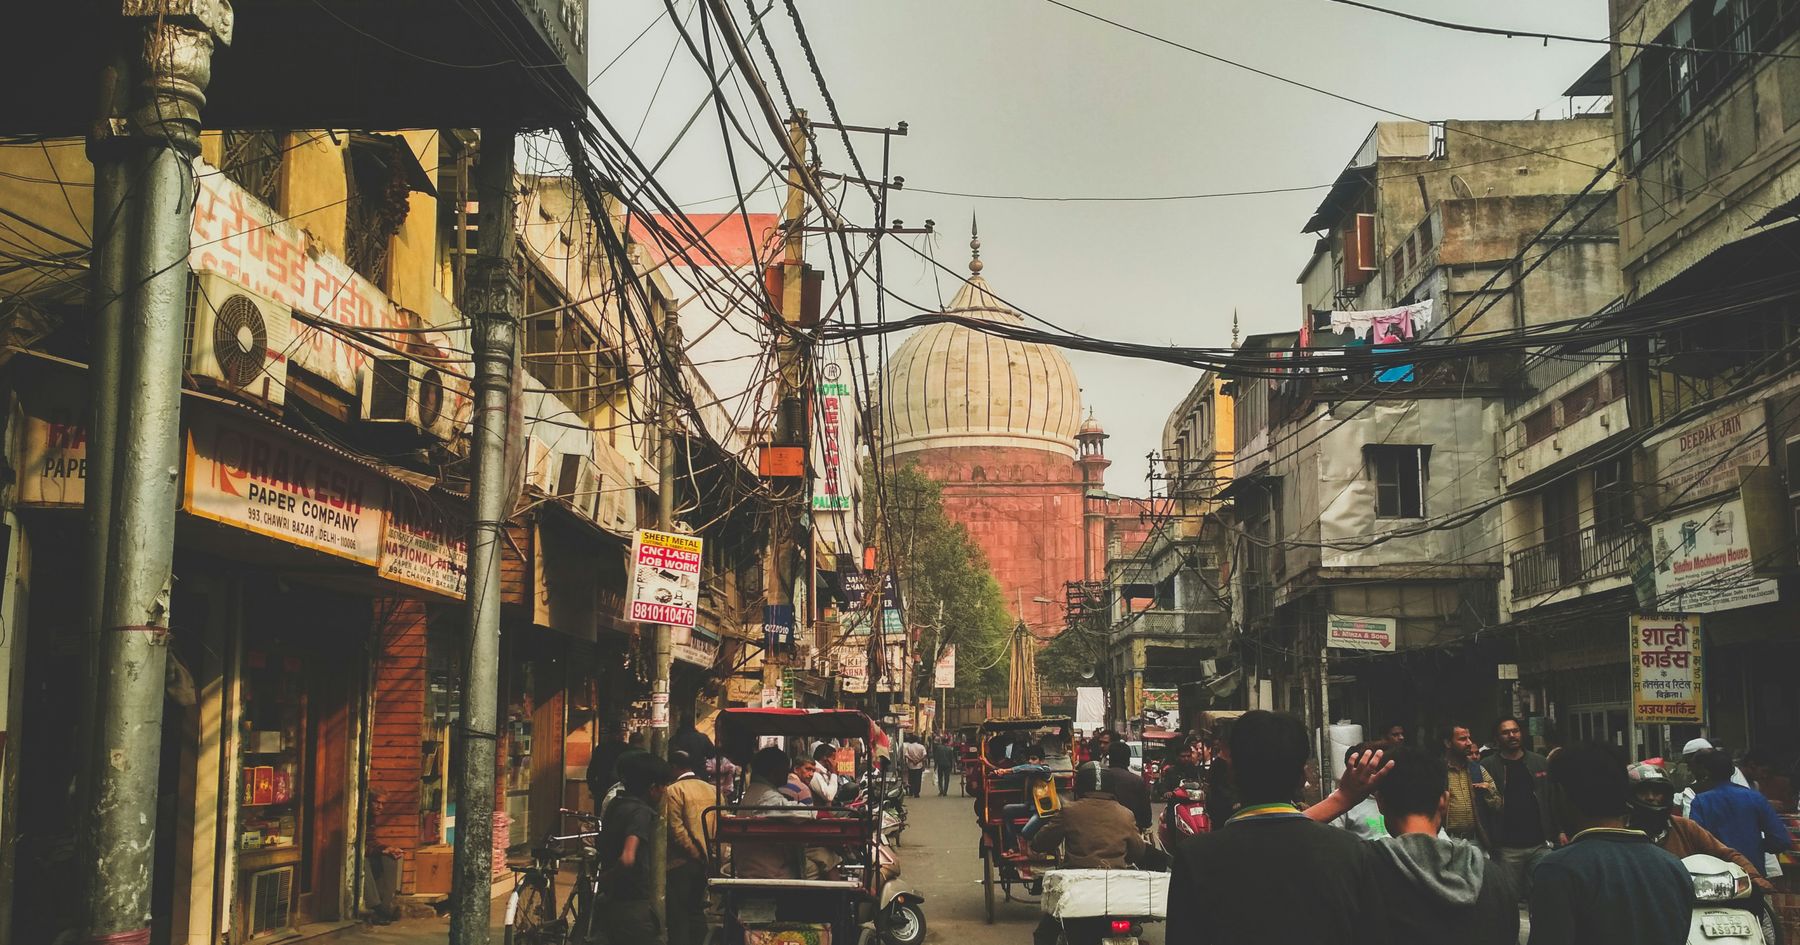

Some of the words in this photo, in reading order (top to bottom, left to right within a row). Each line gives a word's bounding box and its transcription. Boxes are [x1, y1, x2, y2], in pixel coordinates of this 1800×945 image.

[1680, 424, 1716, 452] DEEPAK
[1720, 414, 1742, 437] JAIN
[249, 483, 296, 513] PAPER
[302, 501, 359, 533] COMPANY
[263, 511, 290, 531] CHAWRI
[644, 532, 670, 542] SHEET
[672, 537, 698, 548] METAL
[385, 540, 433, 568] NATIONAL
[641, 545, 664, 556] CNC
[666, 549, 699, 562] LASER
[1673, 560, 1692, 575] Sindhu
[1694, 552, 1726, 570] Machinery
[1727, 547, 1749, 561] House
[640, 556, 662, 566] JOB
[664, 560, 698, 573] WORK
[406, 570, 433, 585] CHAWRI
[634, 603, 694, 624] 9810110476
[1641, 623, 1689, 647] शादी
[1665, 681, 1671, 689] व
[1638, 704, 1664, 715] अजय
